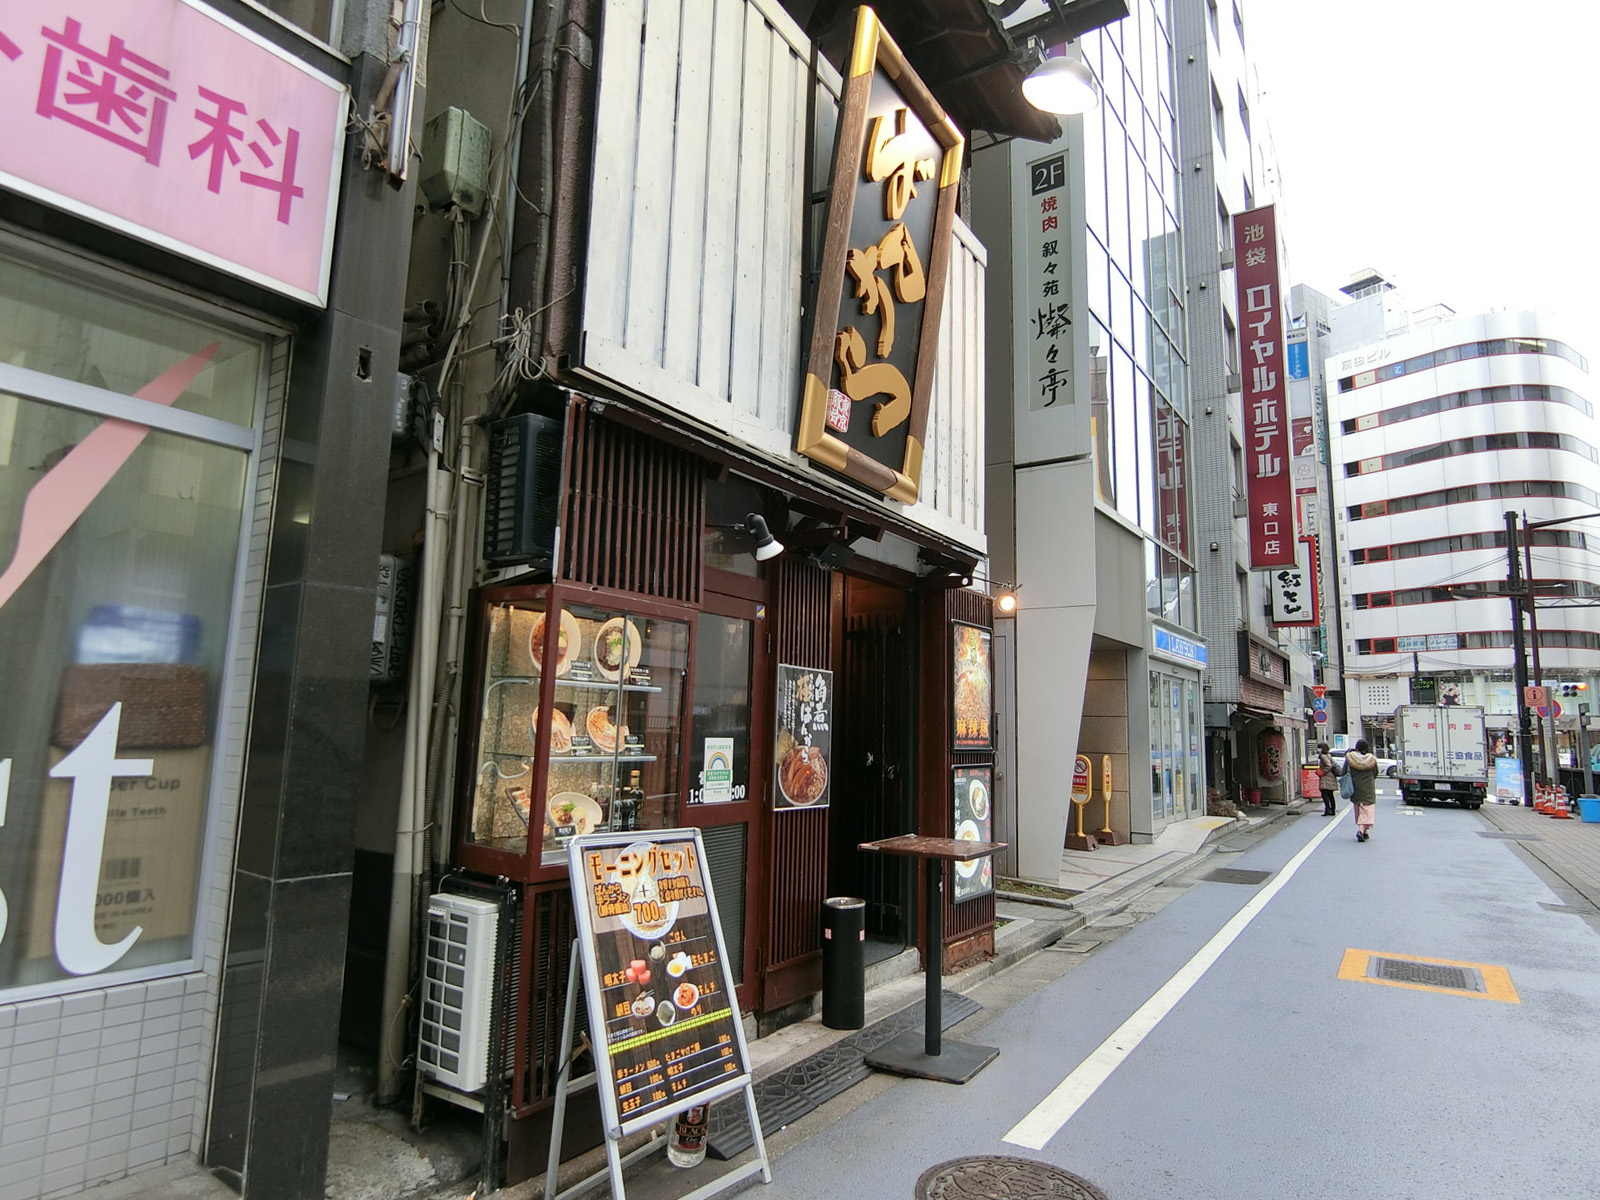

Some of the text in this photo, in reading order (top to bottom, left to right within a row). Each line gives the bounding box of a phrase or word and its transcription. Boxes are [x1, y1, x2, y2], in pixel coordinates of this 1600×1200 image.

[1034, 160, 1064, 192] 2F
[1040, 196, 1059, 234] 焼肉
[834, 106, 936, 438] ばんから
[1243, 223, 1282, 556] 池袋 ロイヤルホテル 東口店
[1171, 636, 1195, 658] LAWSON
[144, 777, 182, 792] Cup
[590, 843, 695, 881] モーニングセット
[603, 970, 626, 987] 明太子
[698, 981, 716, 996] キムチ
[671, 1078, 687, 1092] キムチ
